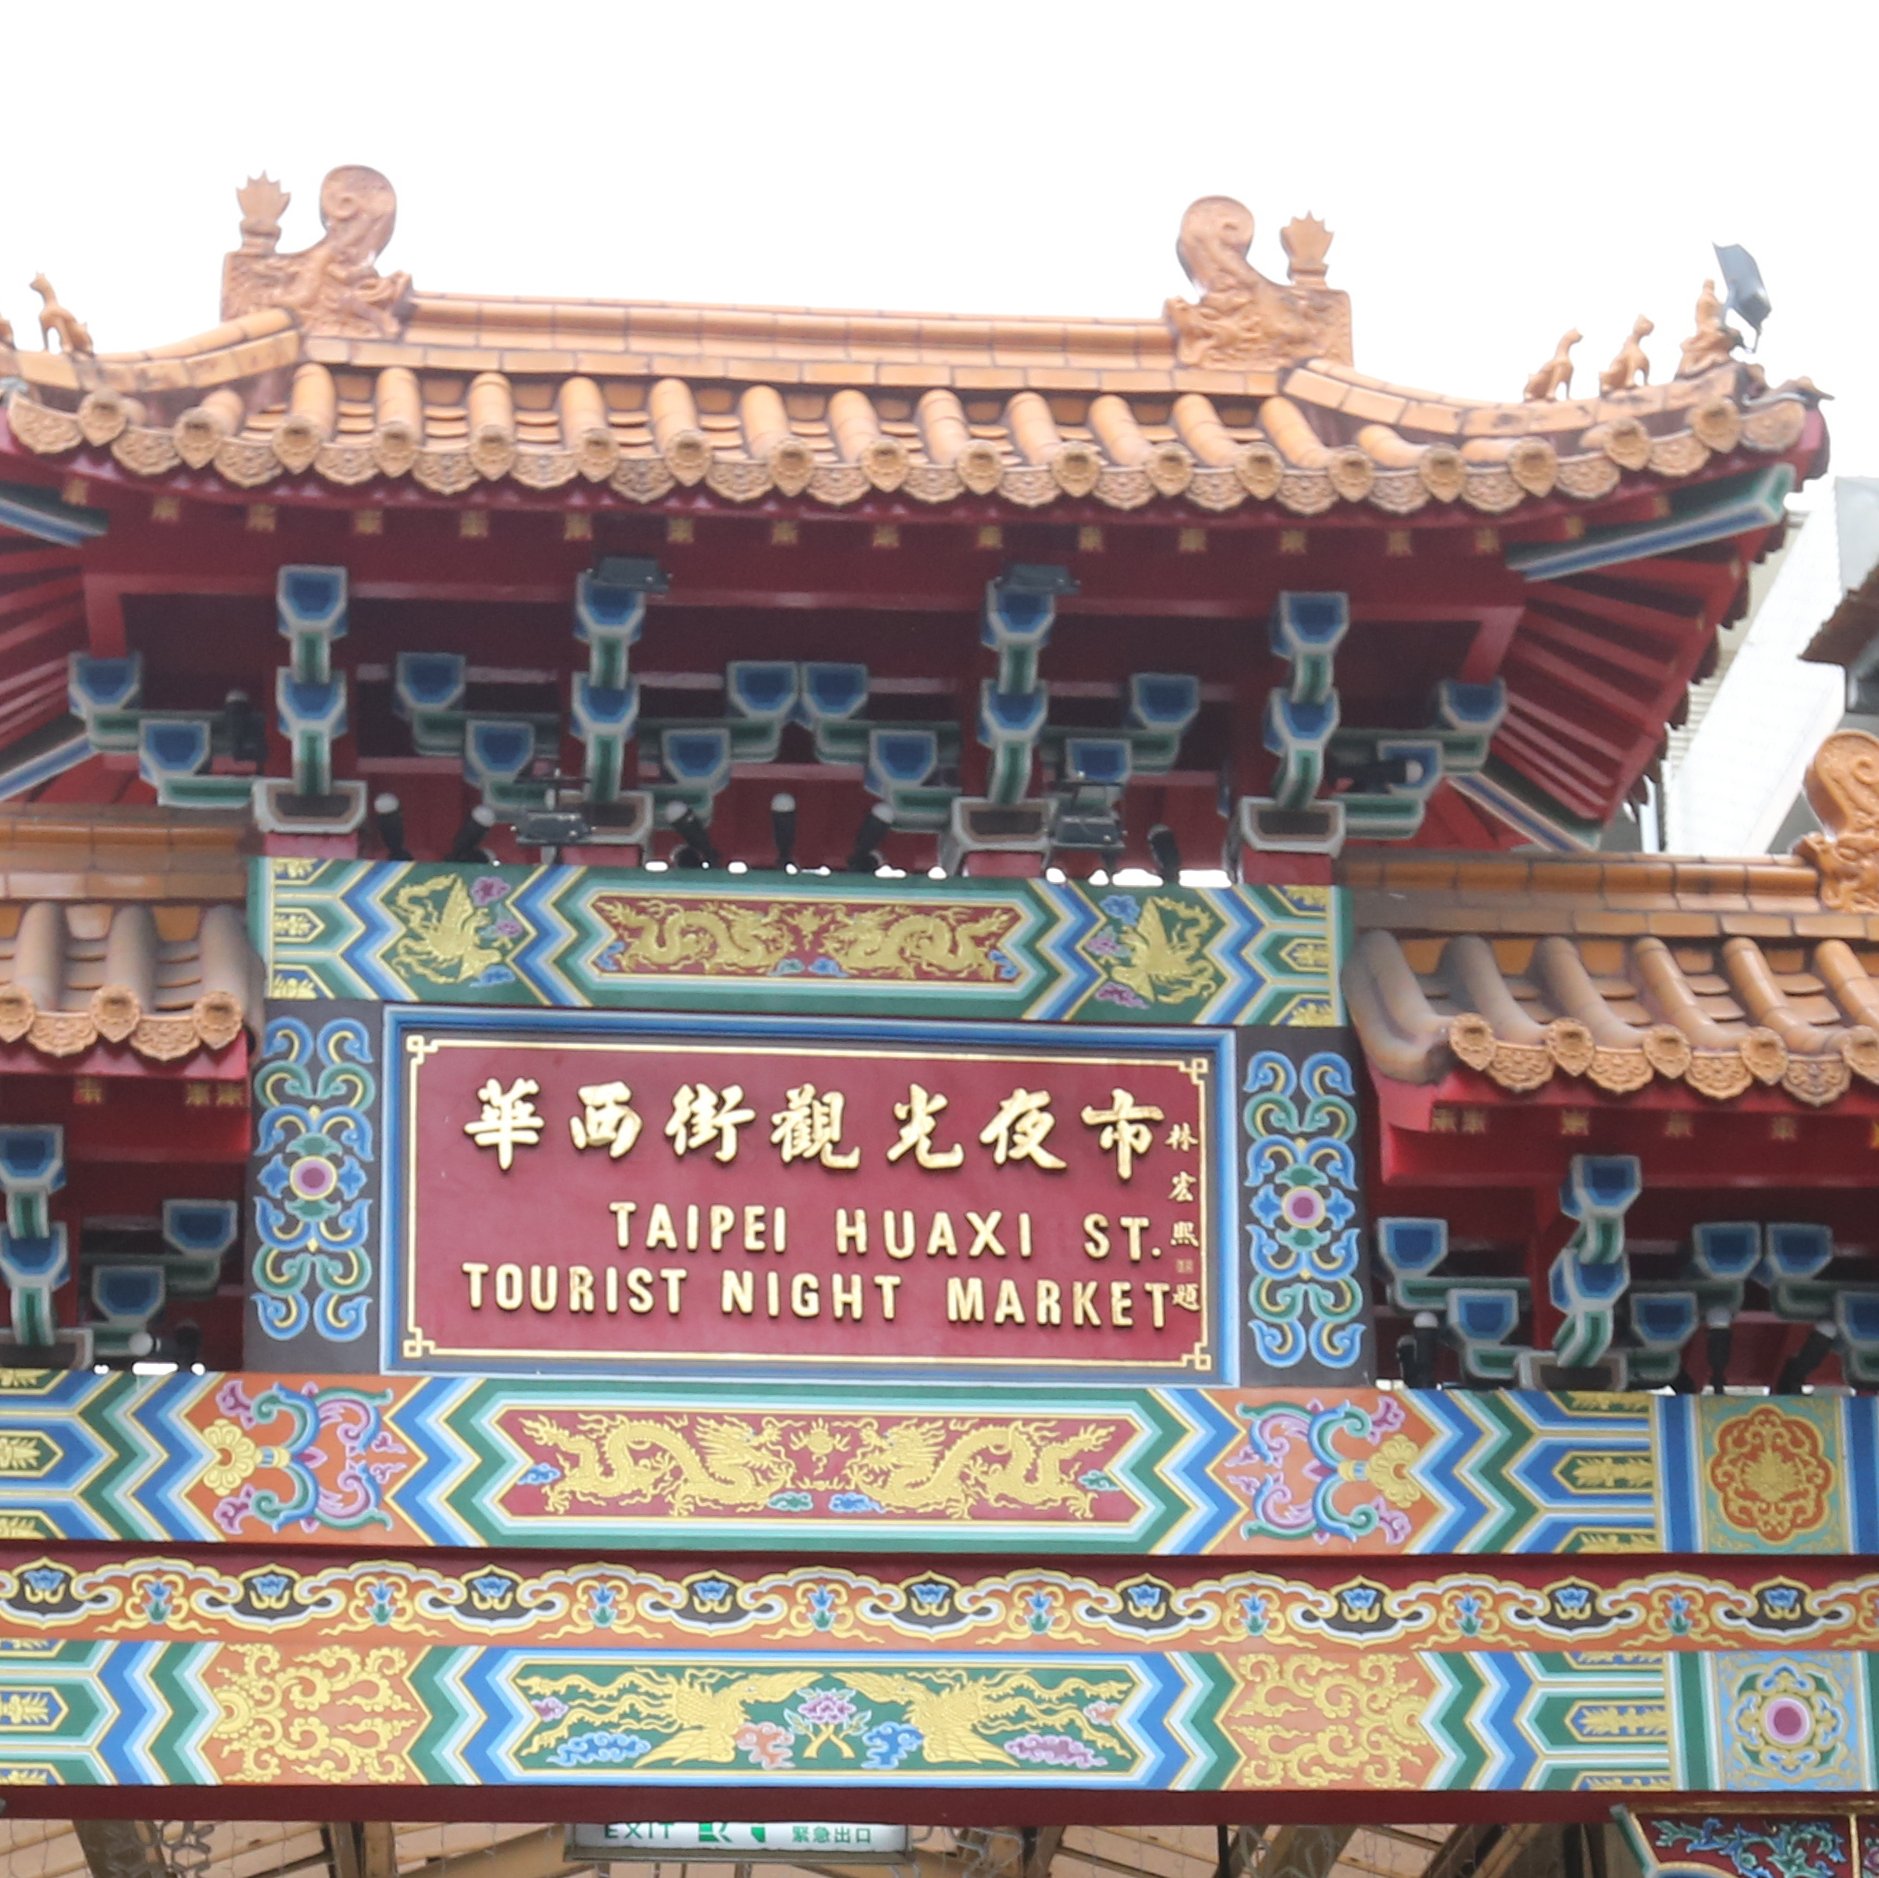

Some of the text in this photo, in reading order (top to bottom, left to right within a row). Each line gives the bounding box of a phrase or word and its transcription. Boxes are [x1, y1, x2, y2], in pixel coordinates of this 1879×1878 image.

[464, 1076, 1164, 1180] 華西街觀光夜市
[609, 1201, 1162, 1261] TAIPEI HUAXI ST.
[461, 1261, 1171, 1329] TOURIST NIGHT MARKET
[604, 1822, 675, 1839] EXIT
[791, 1825, 872, 1844] 緊急出口
